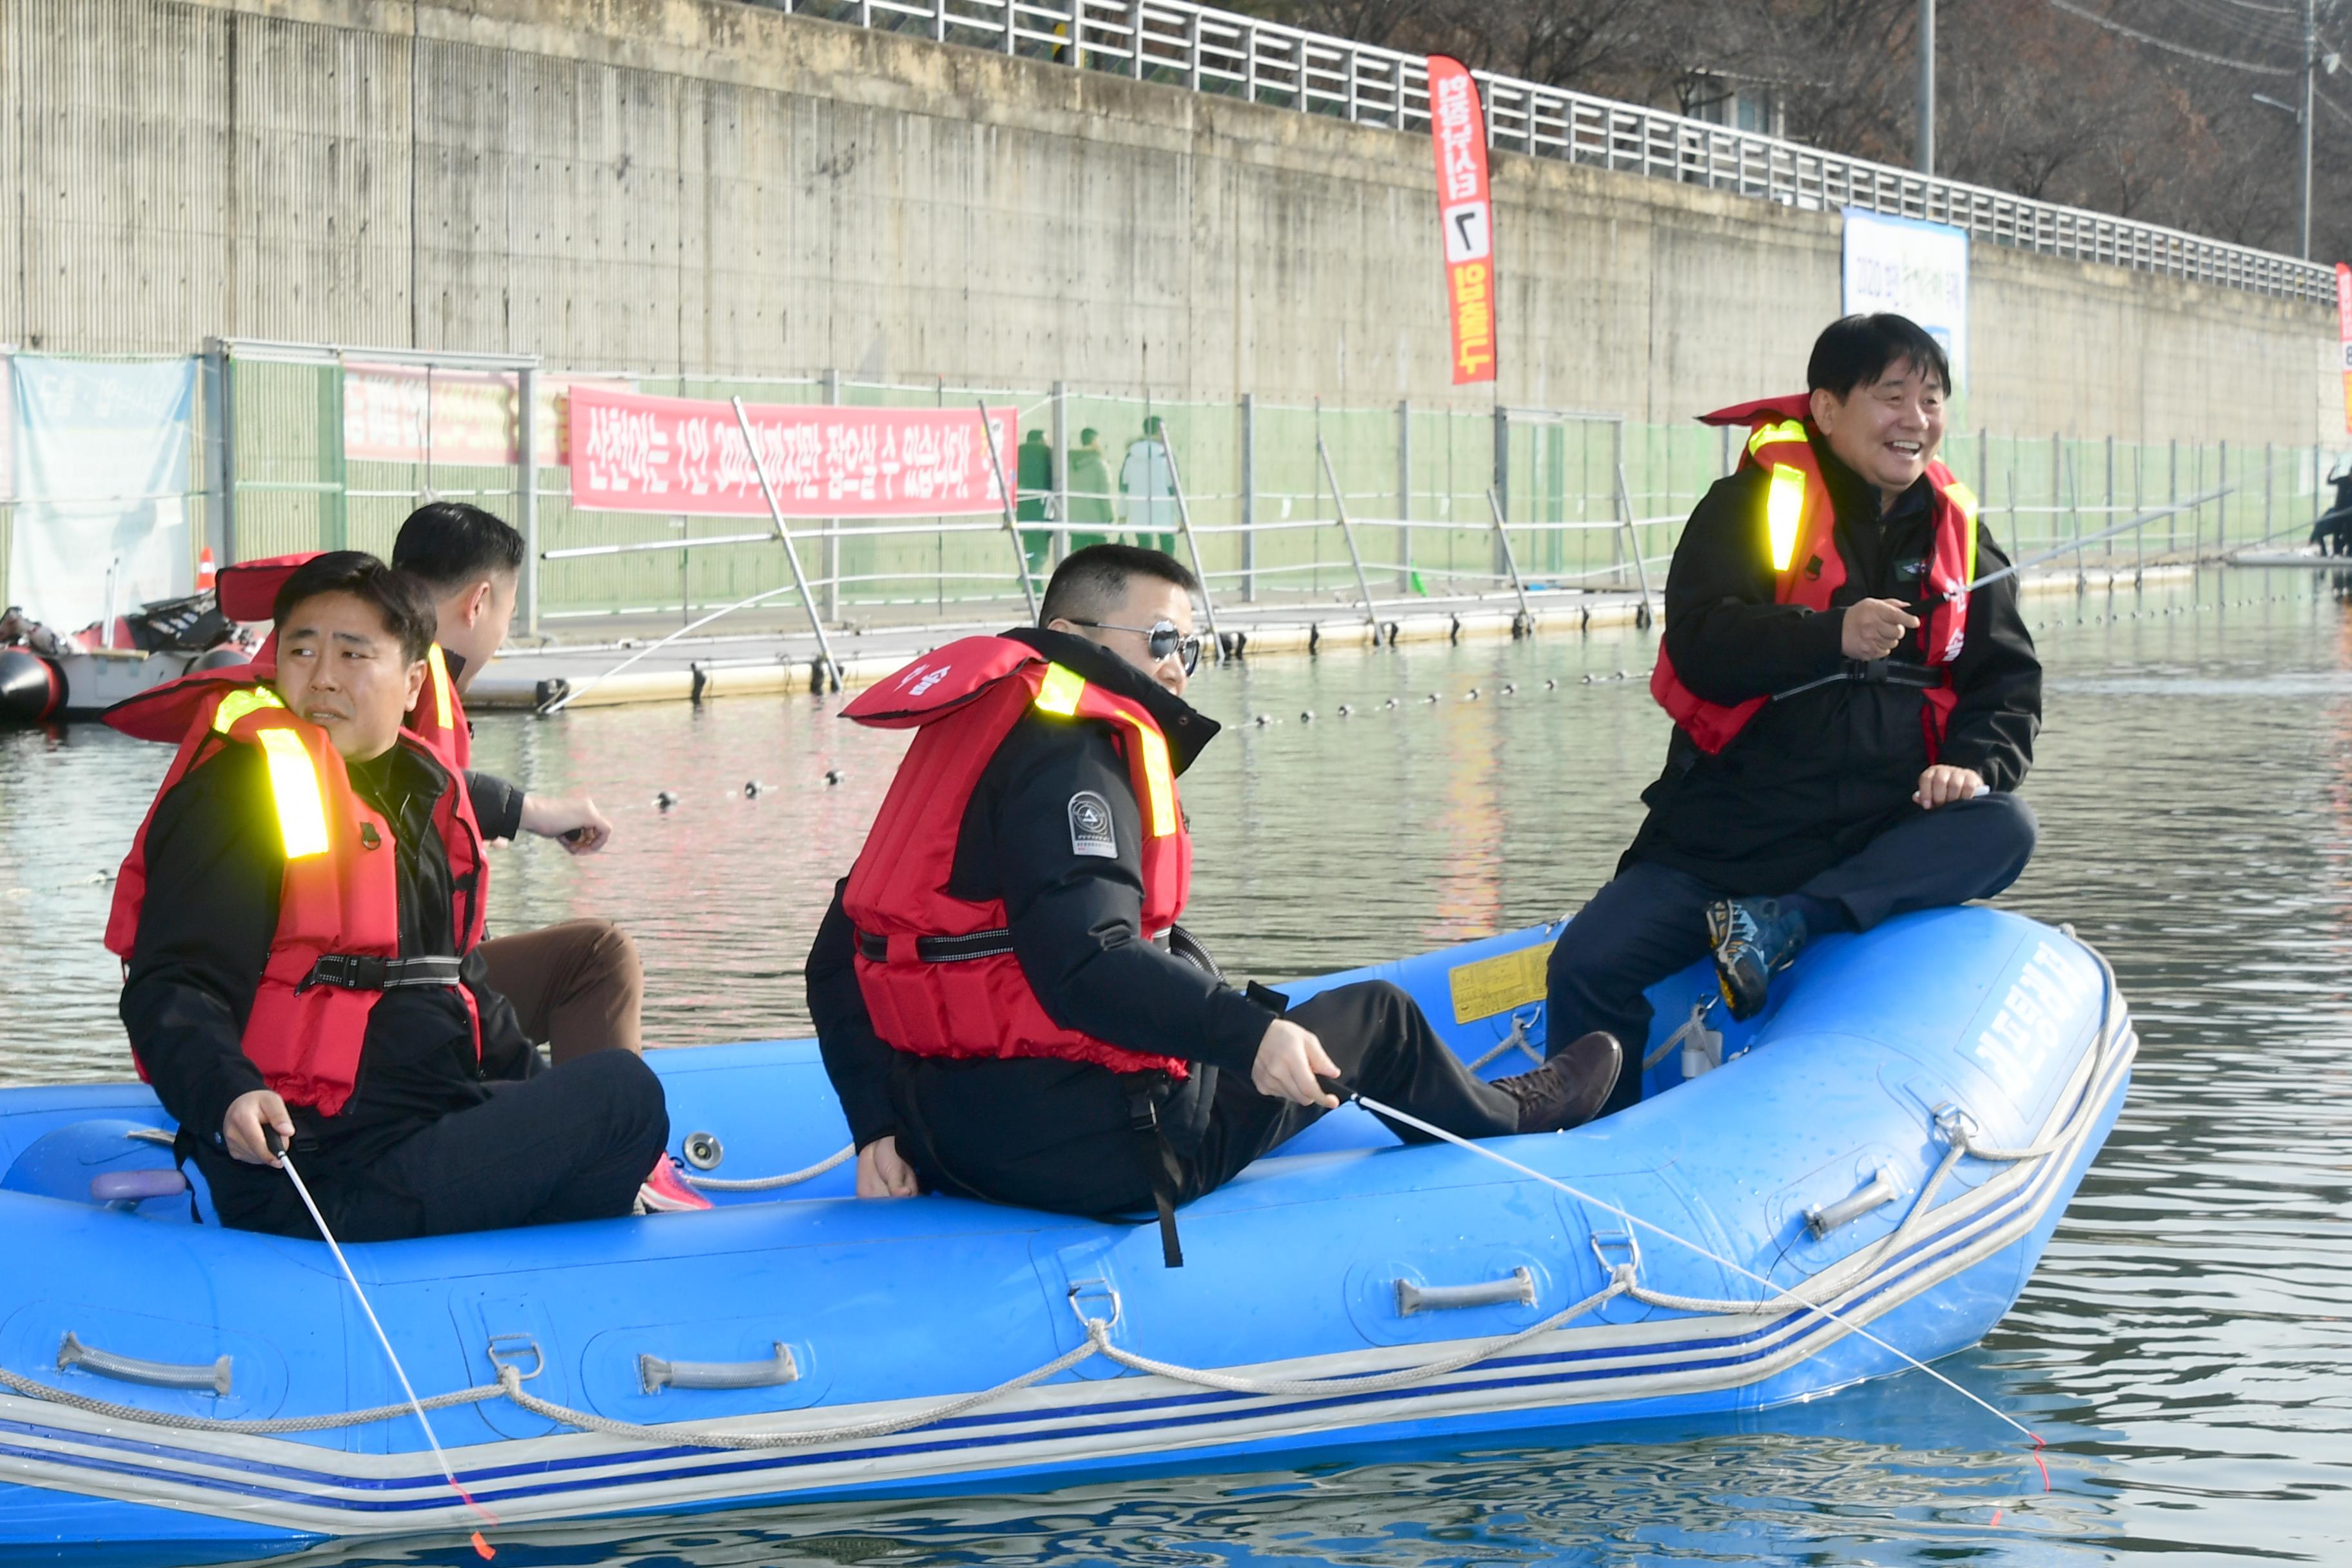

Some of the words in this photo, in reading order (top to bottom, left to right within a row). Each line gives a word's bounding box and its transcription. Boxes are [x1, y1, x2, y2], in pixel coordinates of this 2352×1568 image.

[586, 406, 671, 495] 산천어는
[676, 416, 709, 496] 1인
[714, 421, 821, 500] 3마리까지만
[826, 422, 877, 500] 잡으실
[881, 423, 901, 500] 수
